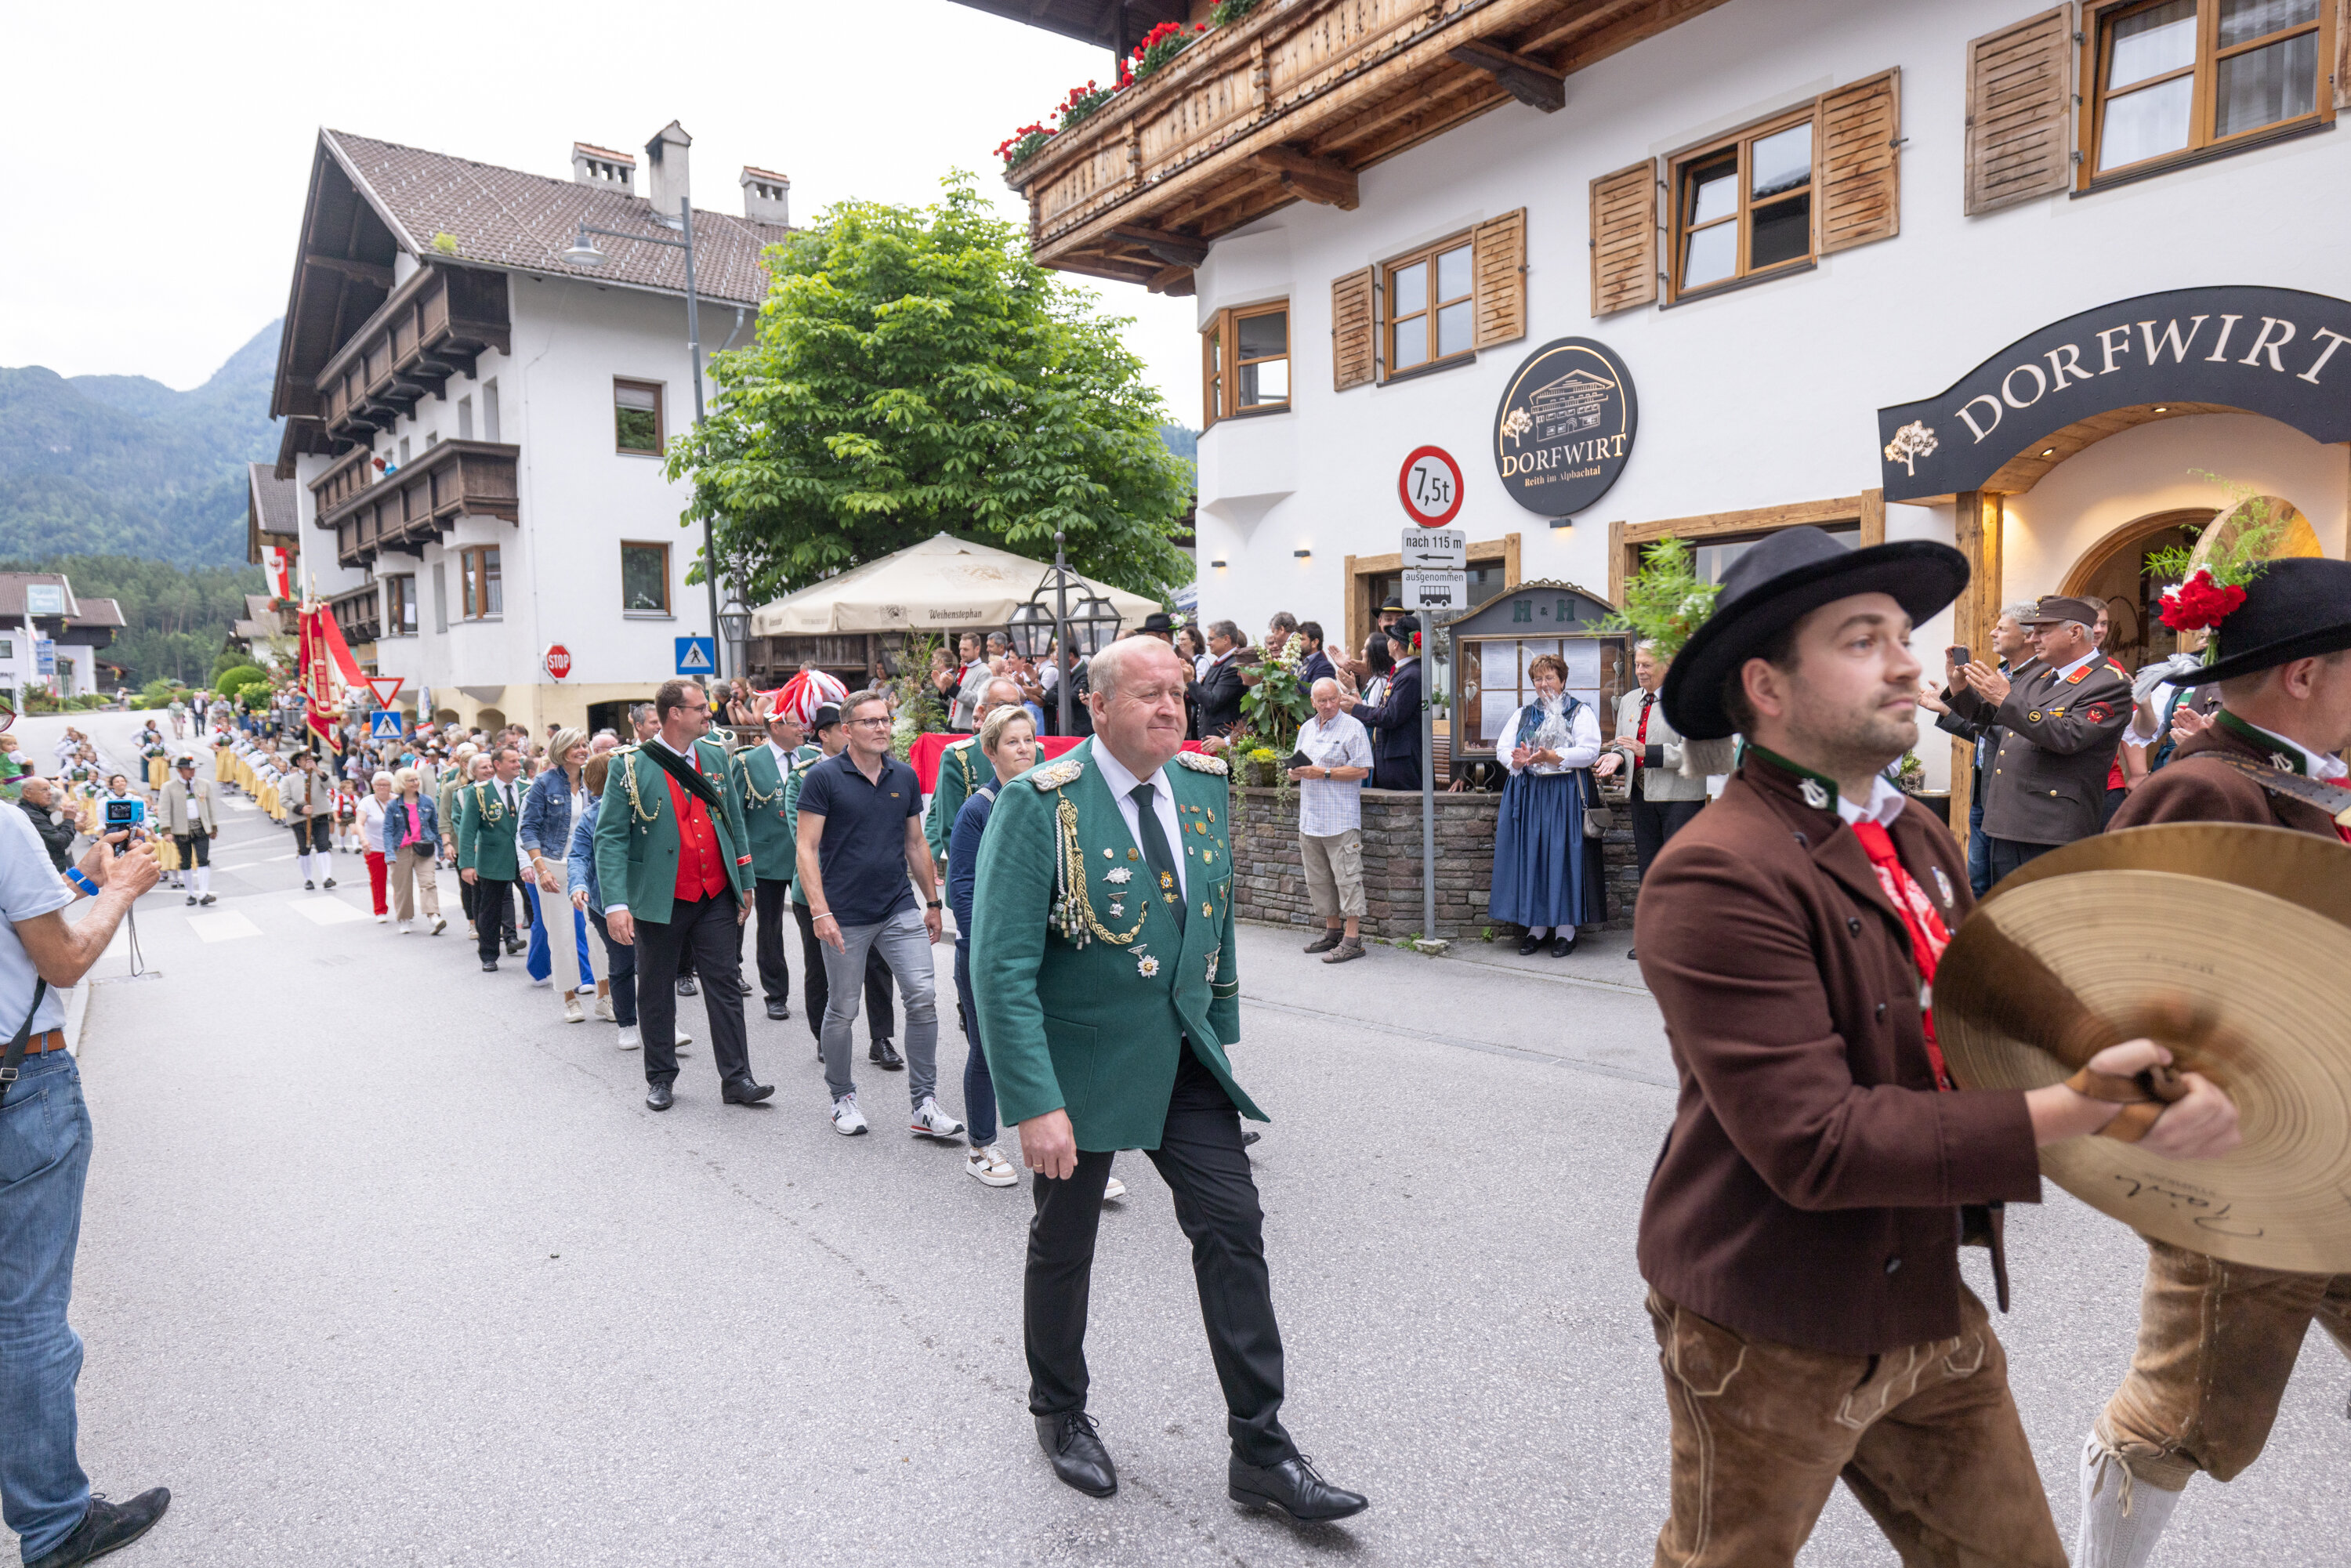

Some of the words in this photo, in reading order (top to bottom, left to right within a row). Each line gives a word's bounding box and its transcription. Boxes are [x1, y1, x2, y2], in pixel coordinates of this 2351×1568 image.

[1954, 314, 2351, 444] DORFWIRT
[1502, 433, 1627, 478] DORFWIRT
[1524, 475, 1545, 487] Reith
[1547, 474, 1557, 483] im
[1559, 465, 1601, 482] Alpbachtal
[1406, 535, 1429, 548] nach
[1432, 536, 1450, 549] 115
[1453, 539, 1462, 549] m
[1405, 573, 1464, 583] ausgenommen
[928, 608, 982, 621] Weihenstephan
[1512, 599, 1532, 622] H
[1540, 607, 1548, 616] &
[1556, 599, 1575, 622] H
[549, 654, 570, 669] STOP
